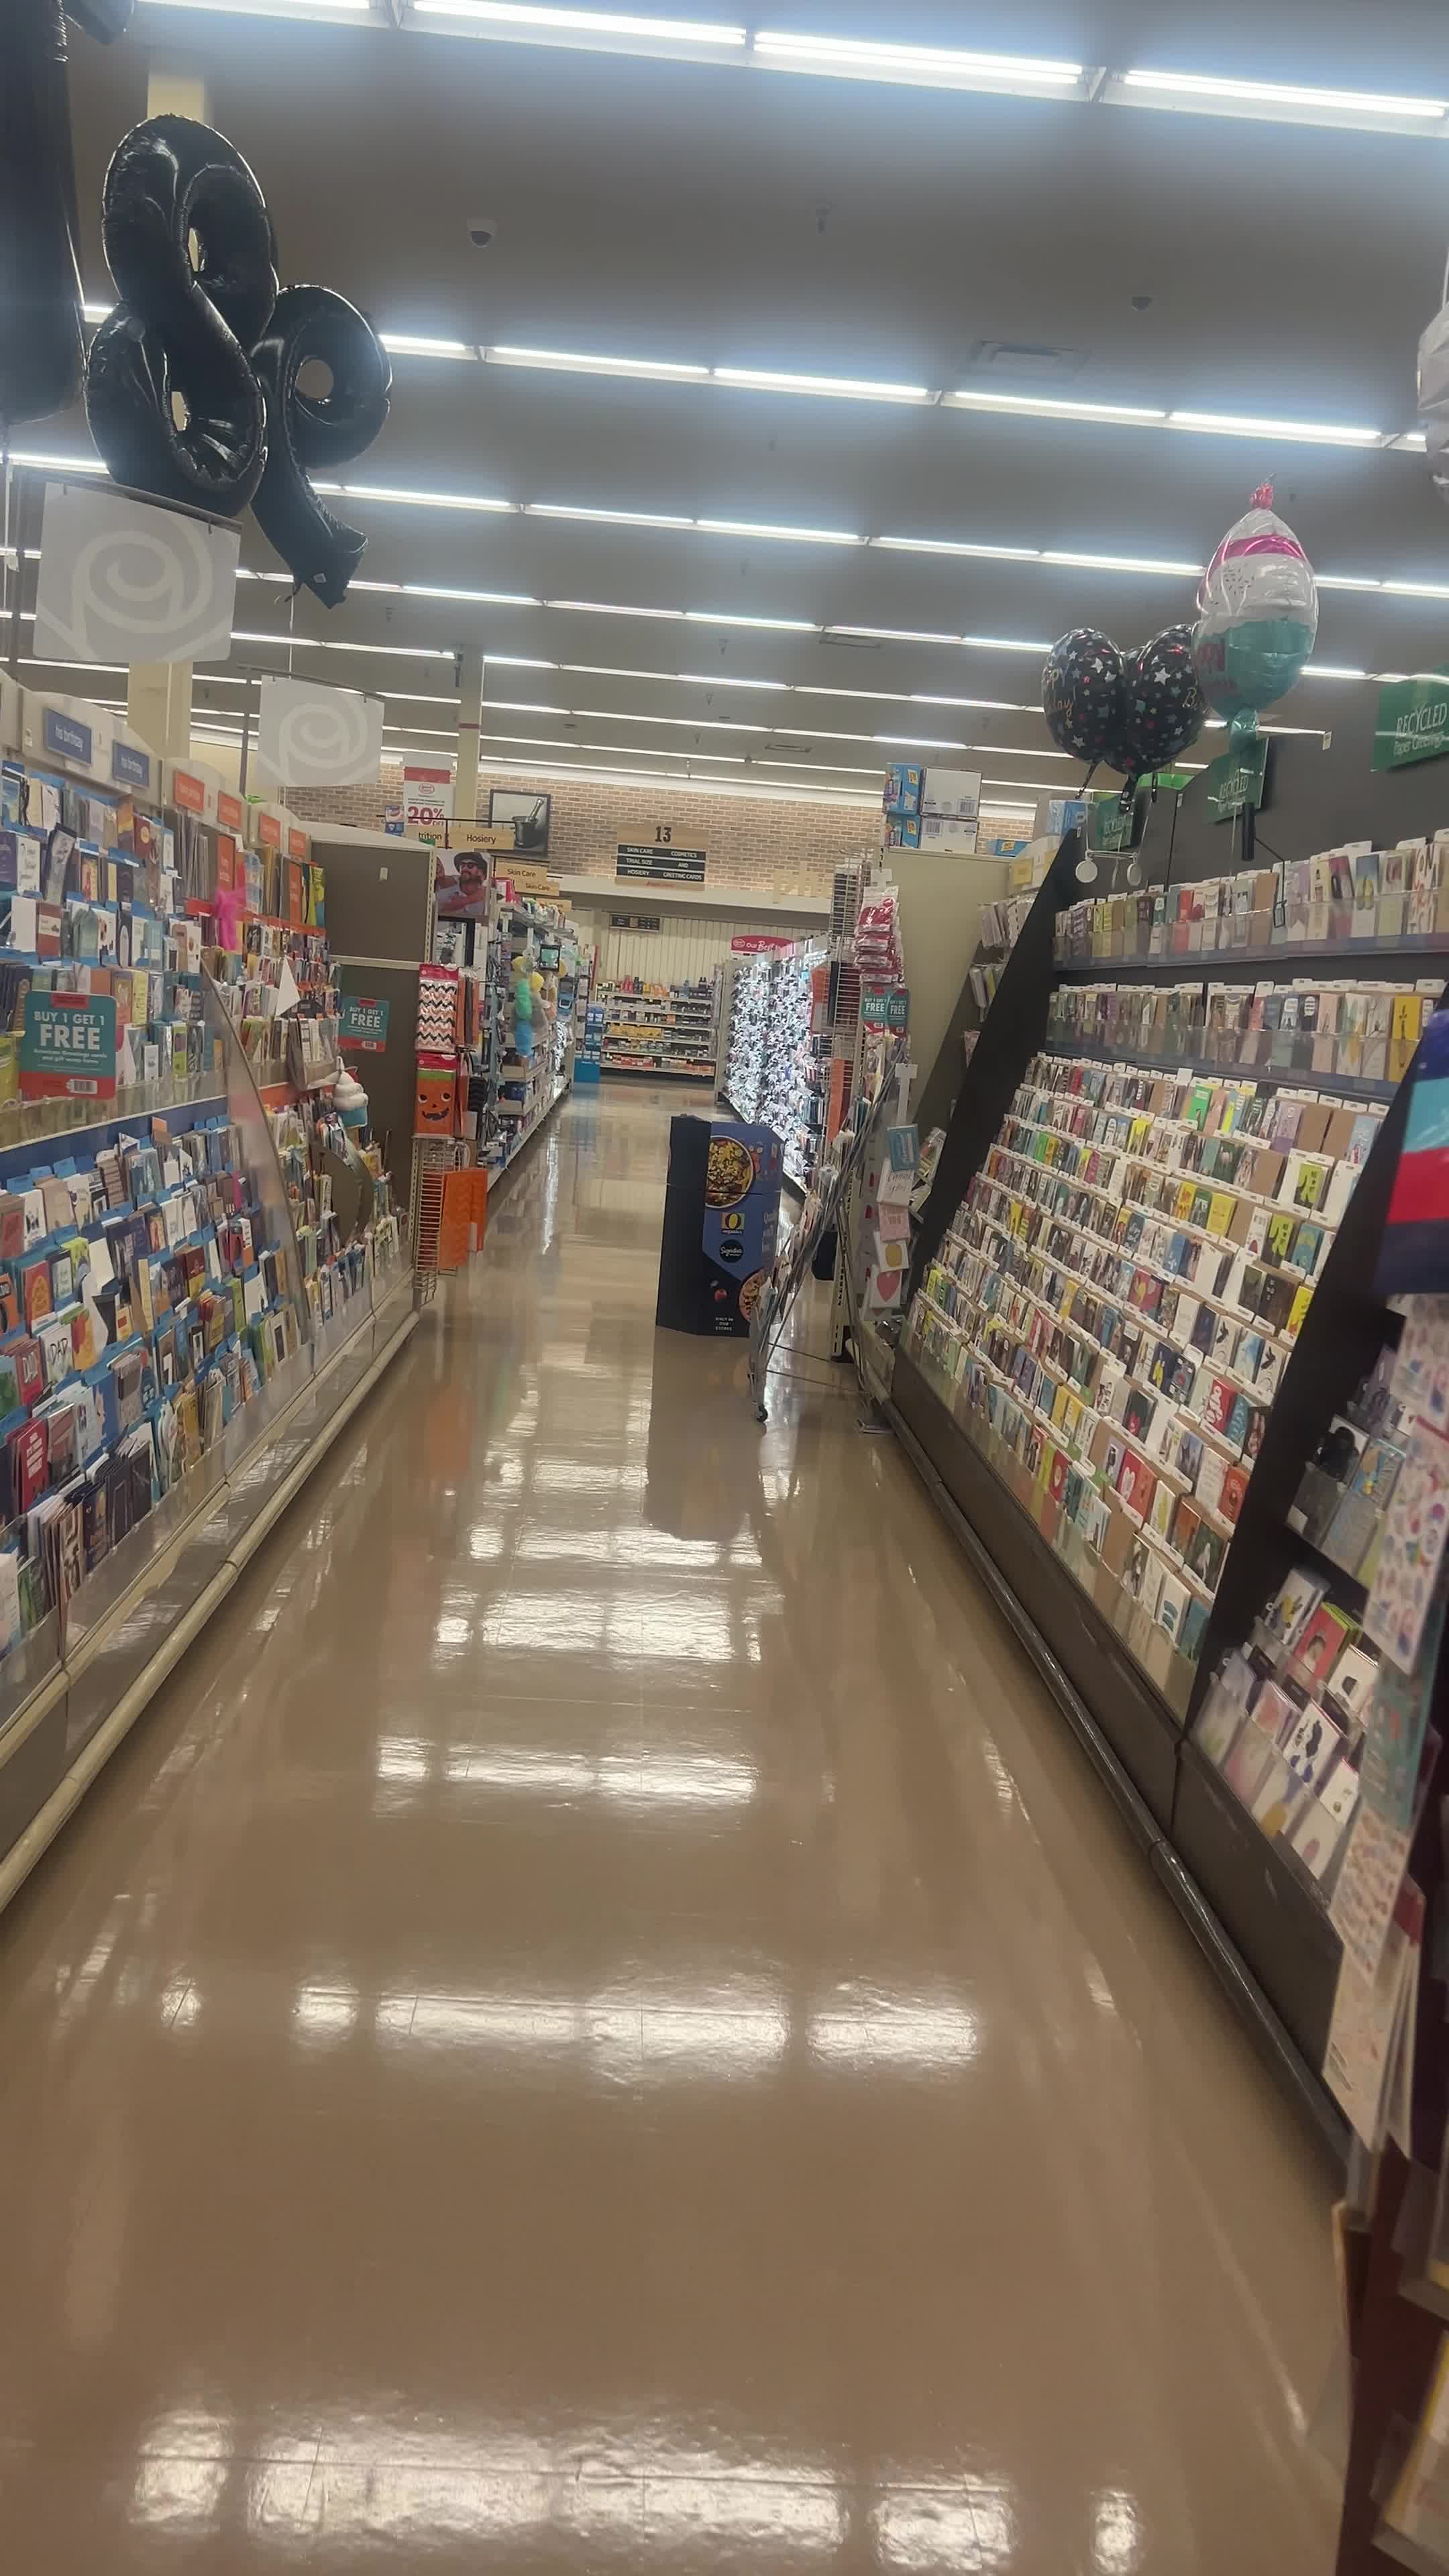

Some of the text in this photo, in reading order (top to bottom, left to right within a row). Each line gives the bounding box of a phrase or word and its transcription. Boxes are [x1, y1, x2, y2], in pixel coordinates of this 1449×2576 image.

[1395, 703, 1447, 738] RECYCLED
[407, 806, 444, 826] 20%
[419, 831, 442, 840] trition
[466, 834, 496, 845] Hosiery
[655, 826, 672, 843] 13
[865, 1003, 885, 1012] FREE
[891, 1006, 906, 1015] FREE
[34, 1011, 105, 1025] BUY 1 GET 1
[351, 1013, 381, 1028] FREE
[40, 1024, 100, 1051] FREE
